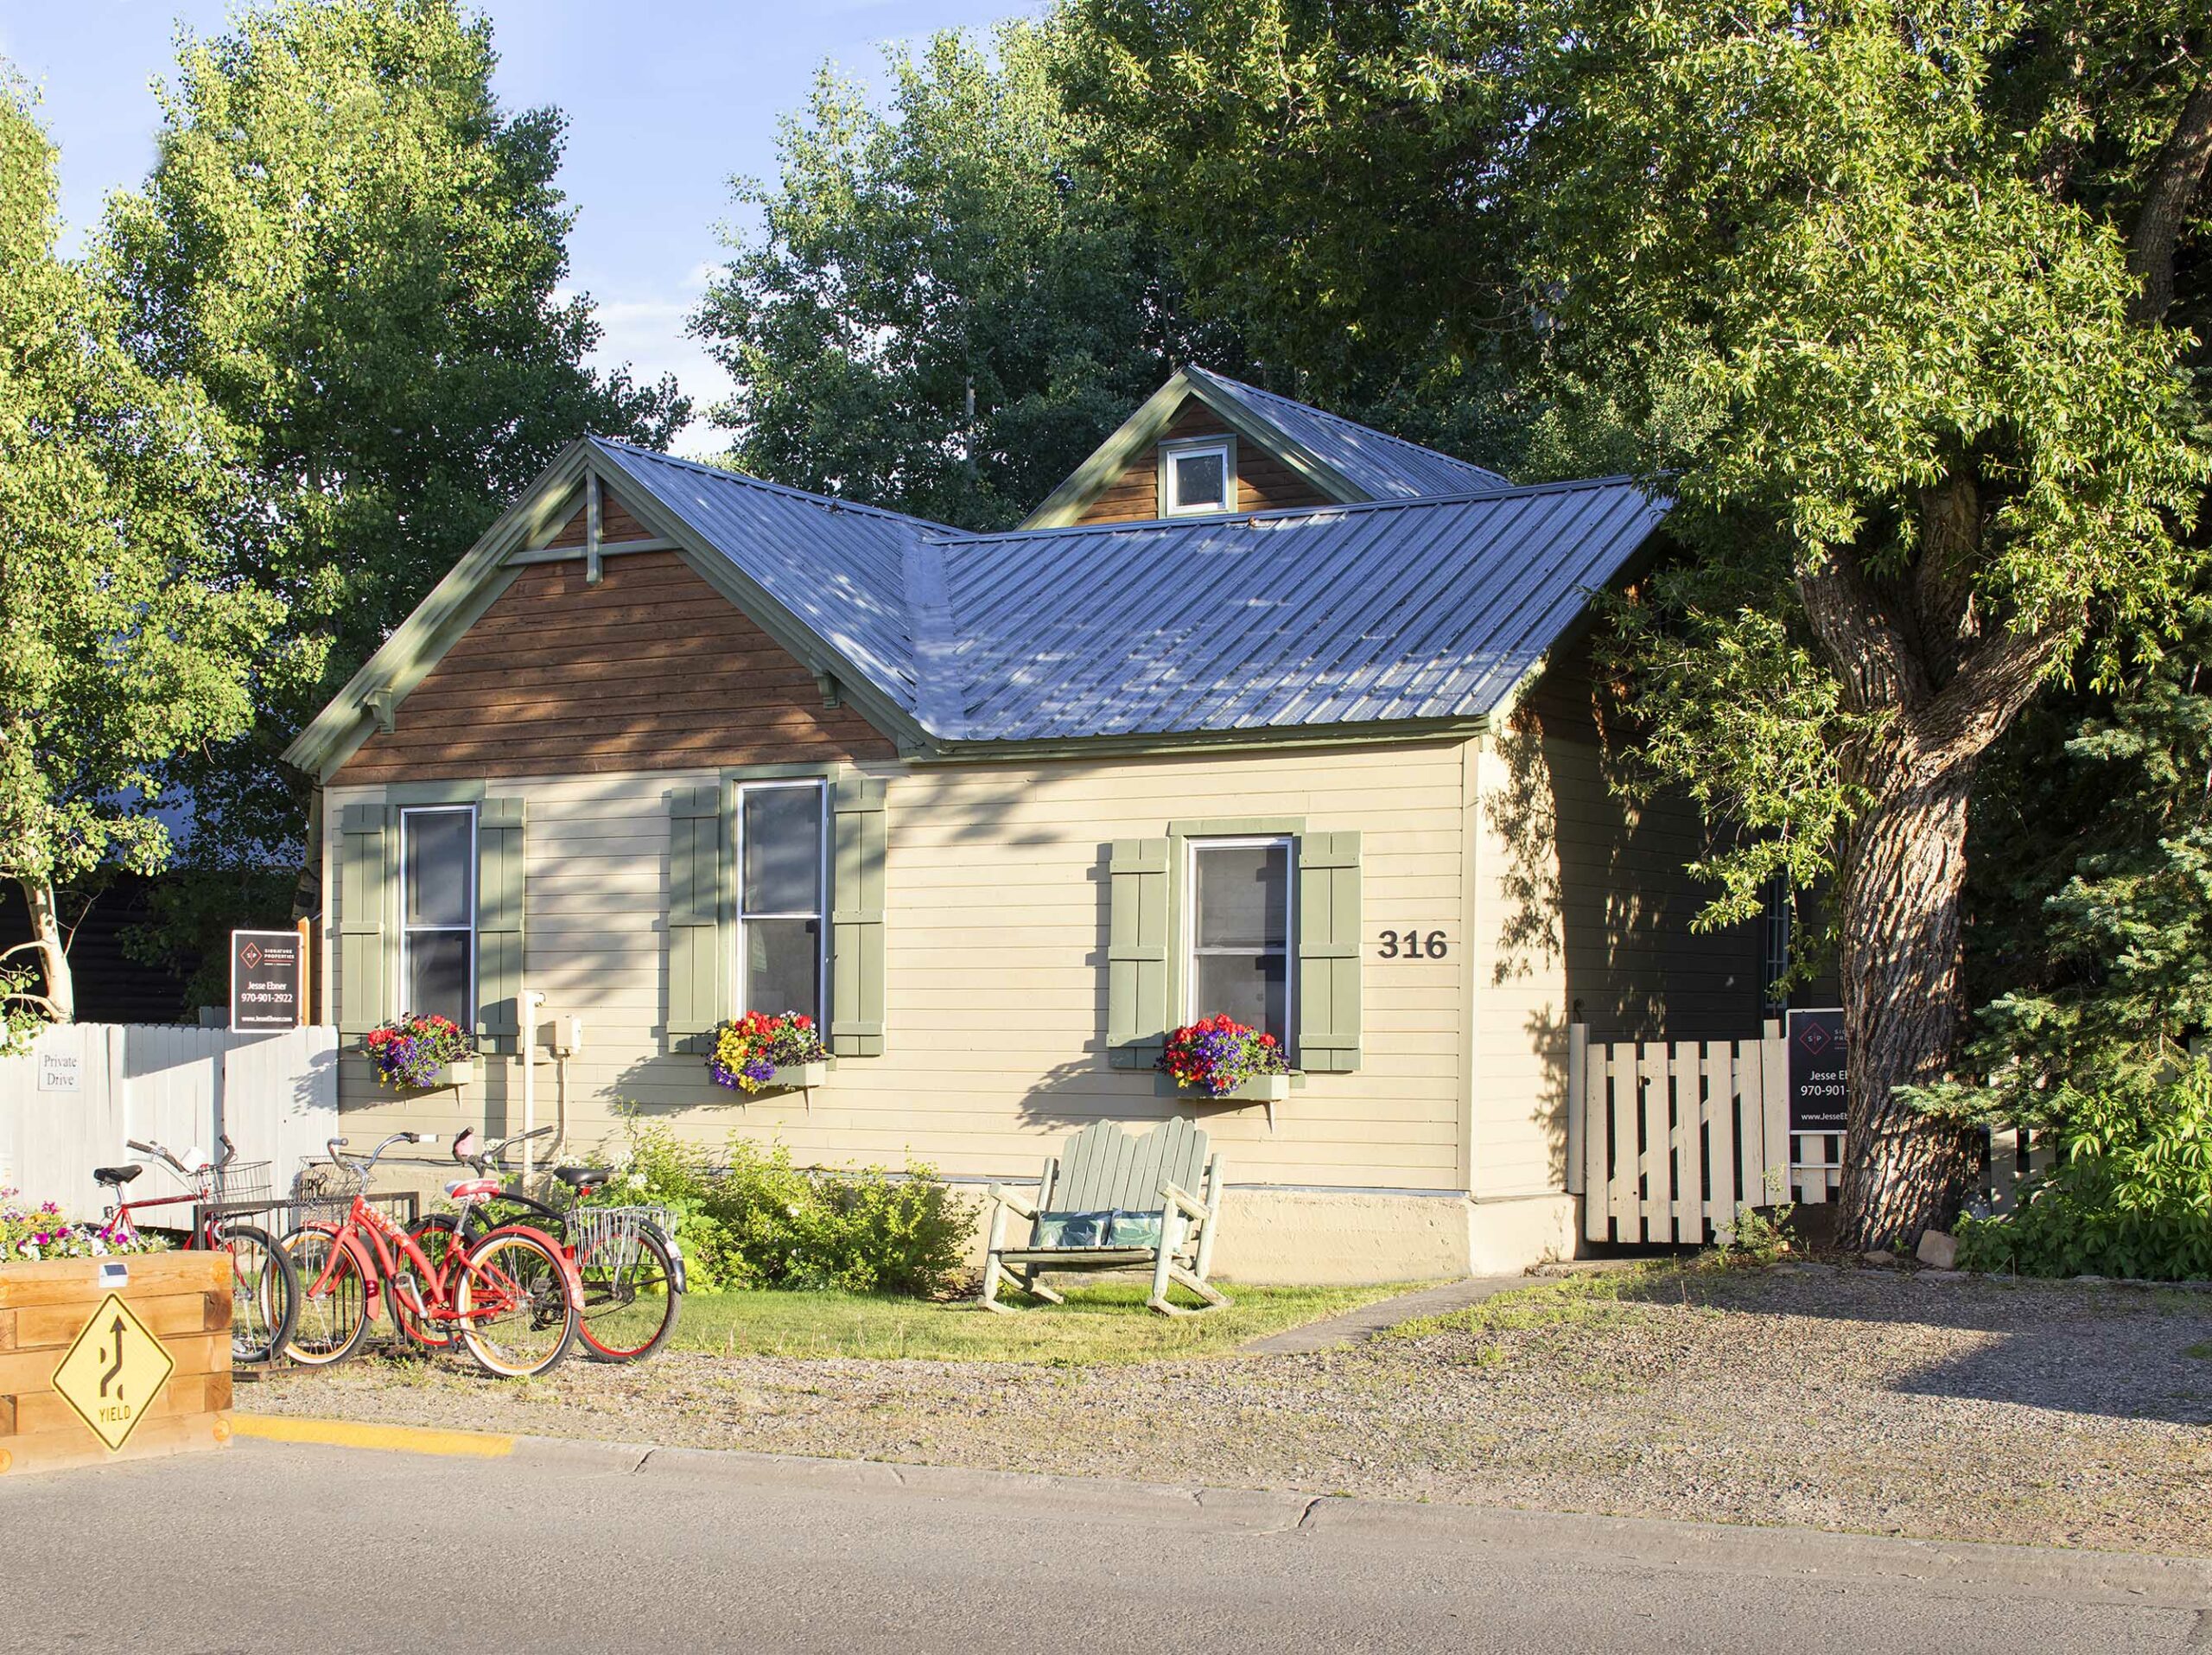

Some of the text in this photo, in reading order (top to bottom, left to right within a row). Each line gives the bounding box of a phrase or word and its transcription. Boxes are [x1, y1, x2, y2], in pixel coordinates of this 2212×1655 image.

[1377, 930, 1447, 958] 316
[248, 981, 287, 990] Jesse Ebner
[241, 993, 293, 1003] 970-901-2922
[44, 1054, 77, 1067] Private
[47, 1073, 74, 1085] Drive
[1809, 1071, 1837, 1080] Jesse
[99, 1405, 131, 1423] YIELD
